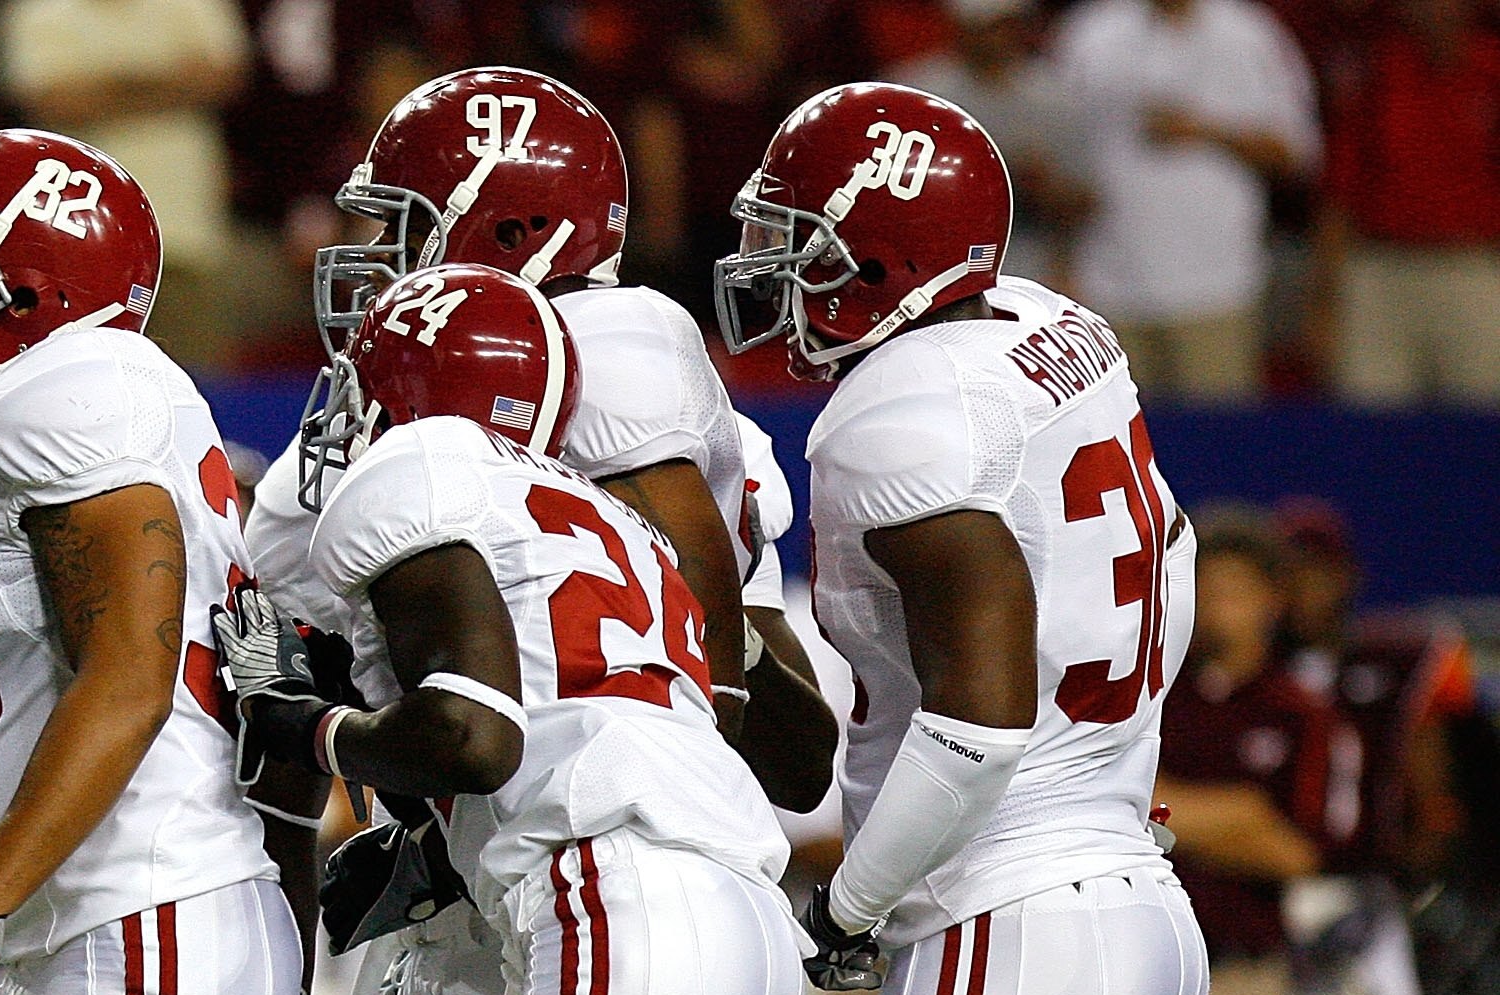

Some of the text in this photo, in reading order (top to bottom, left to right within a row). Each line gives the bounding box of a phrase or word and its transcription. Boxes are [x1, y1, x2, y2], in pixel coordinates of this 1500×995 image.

[466, 94, 537, 159] 97
[865, 121, 936, 201] 30
[383, 276, 469, 347] 24
[524, 483, 714, 710] 24
